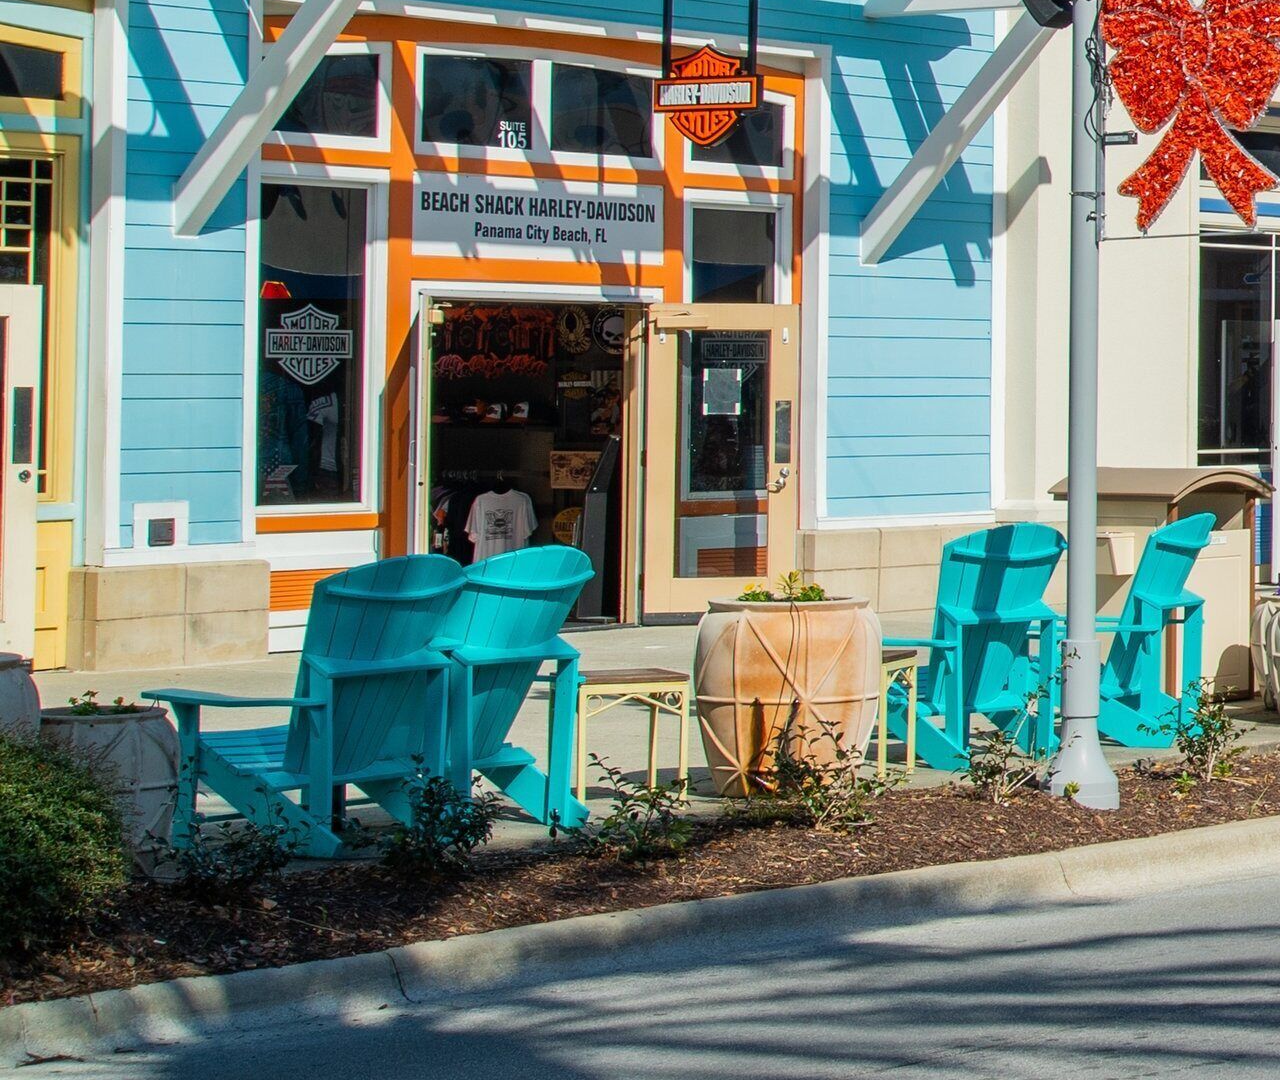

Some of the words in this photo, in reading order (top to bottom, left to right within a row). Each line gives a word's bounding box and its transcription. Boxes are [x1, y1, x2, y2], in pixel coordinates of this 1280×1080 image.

[681, 53, 731, 77] MOTOR
[659, 81, 751, 106] HARLEY-DAVIDSON
[499, 120, 526, 132] SUITE
[681, 110, 730, 139] CYCLES
[498, 131, 527, 149] 105
[421, 191, 469, 213] BEACH
[475, 195, 524, 216] SHACK
[529, 198, 656, 223] HARLEY-DAVIDSON
[474, 221, 522, 240] Panama
[526, 224, 550, 243] City
[553, 226, 591, 245] Beach,
[595, 228, 607, 243] FL
[290, 313, 330, 330] MOTOR
[272, 335, 347, 351] HARLEY-DAVIDSON
[289, 357, 329, 378] CYCLES
